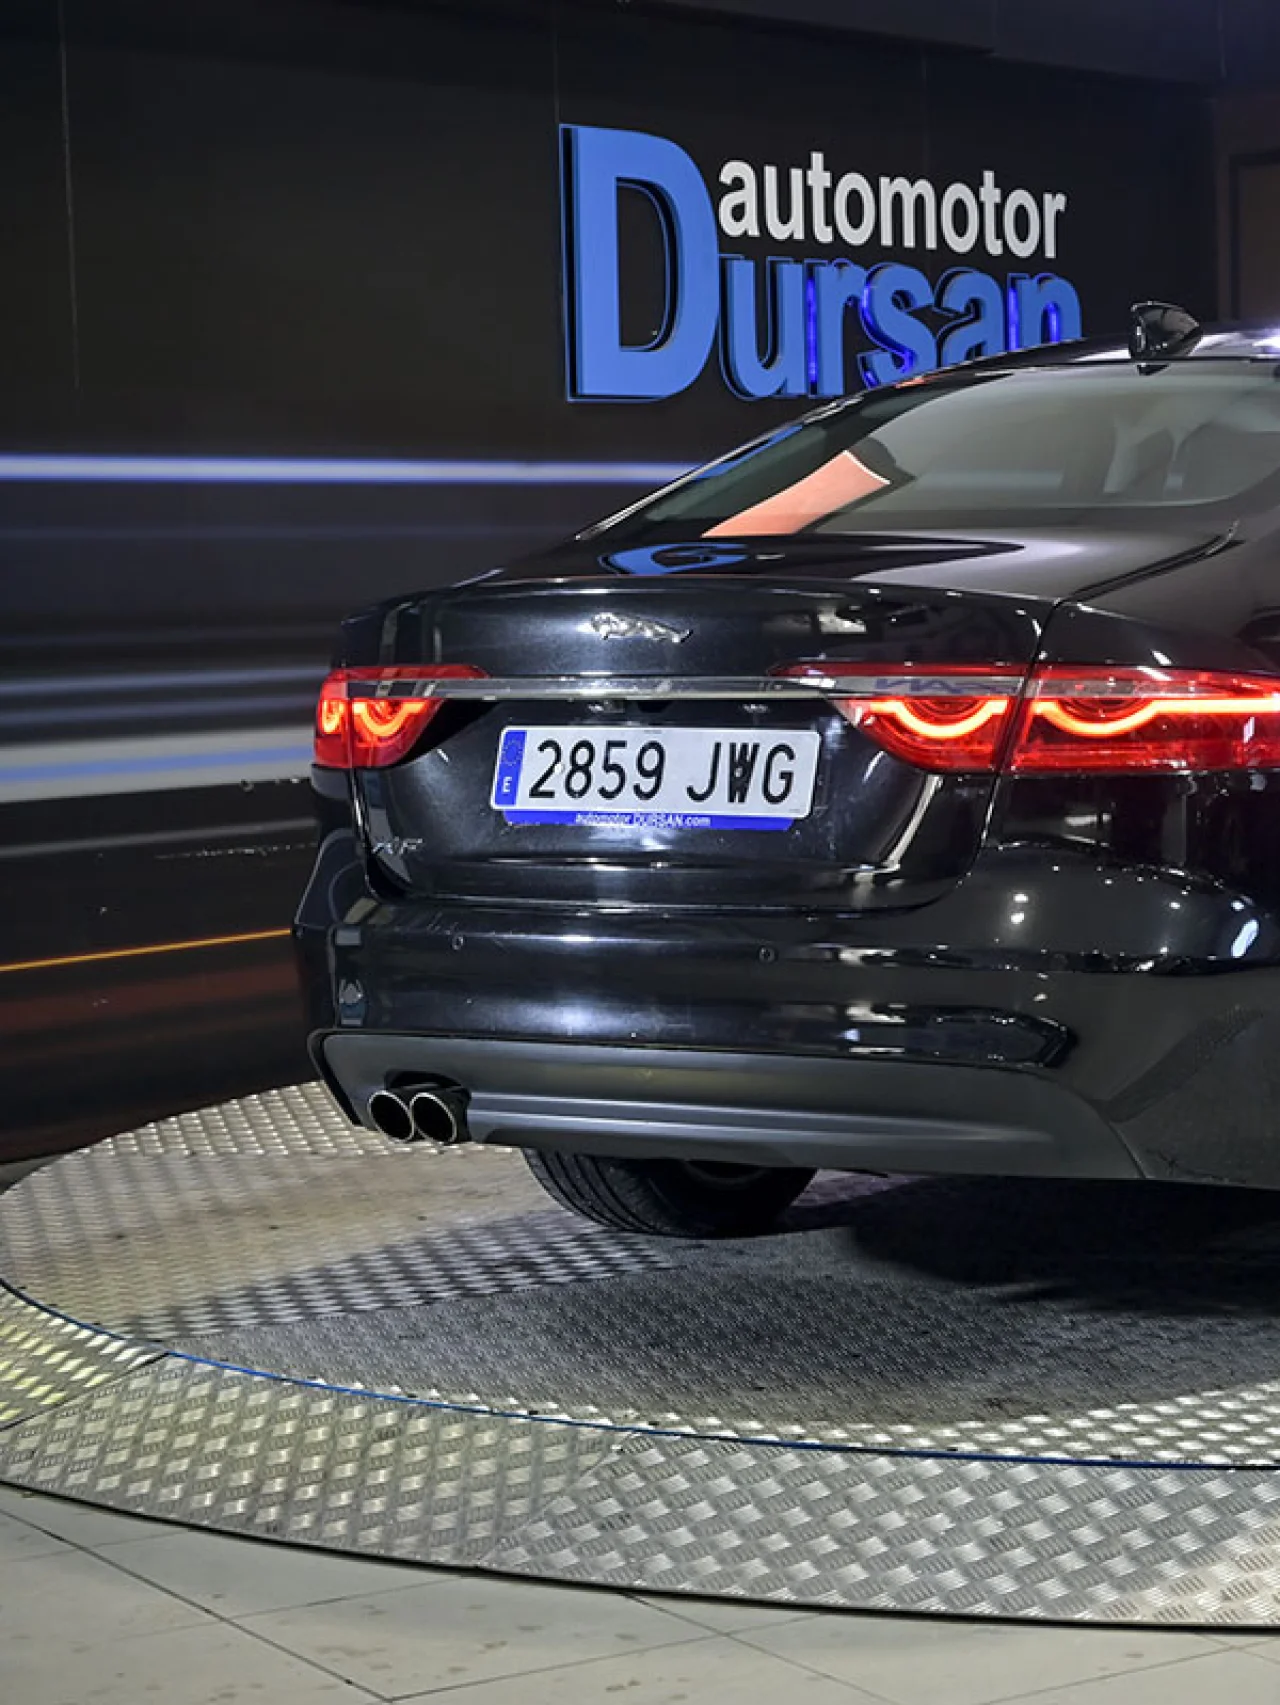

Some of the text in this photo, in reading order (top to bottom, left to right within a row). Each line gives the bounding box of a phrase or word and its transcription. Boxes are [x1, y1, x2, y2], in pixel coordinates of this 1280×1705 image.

[718, 151, 1067, 260] automotor
[560, 123, 1083, 402] Dursan
[501, 739, 796, 804] E 2859 JWG
